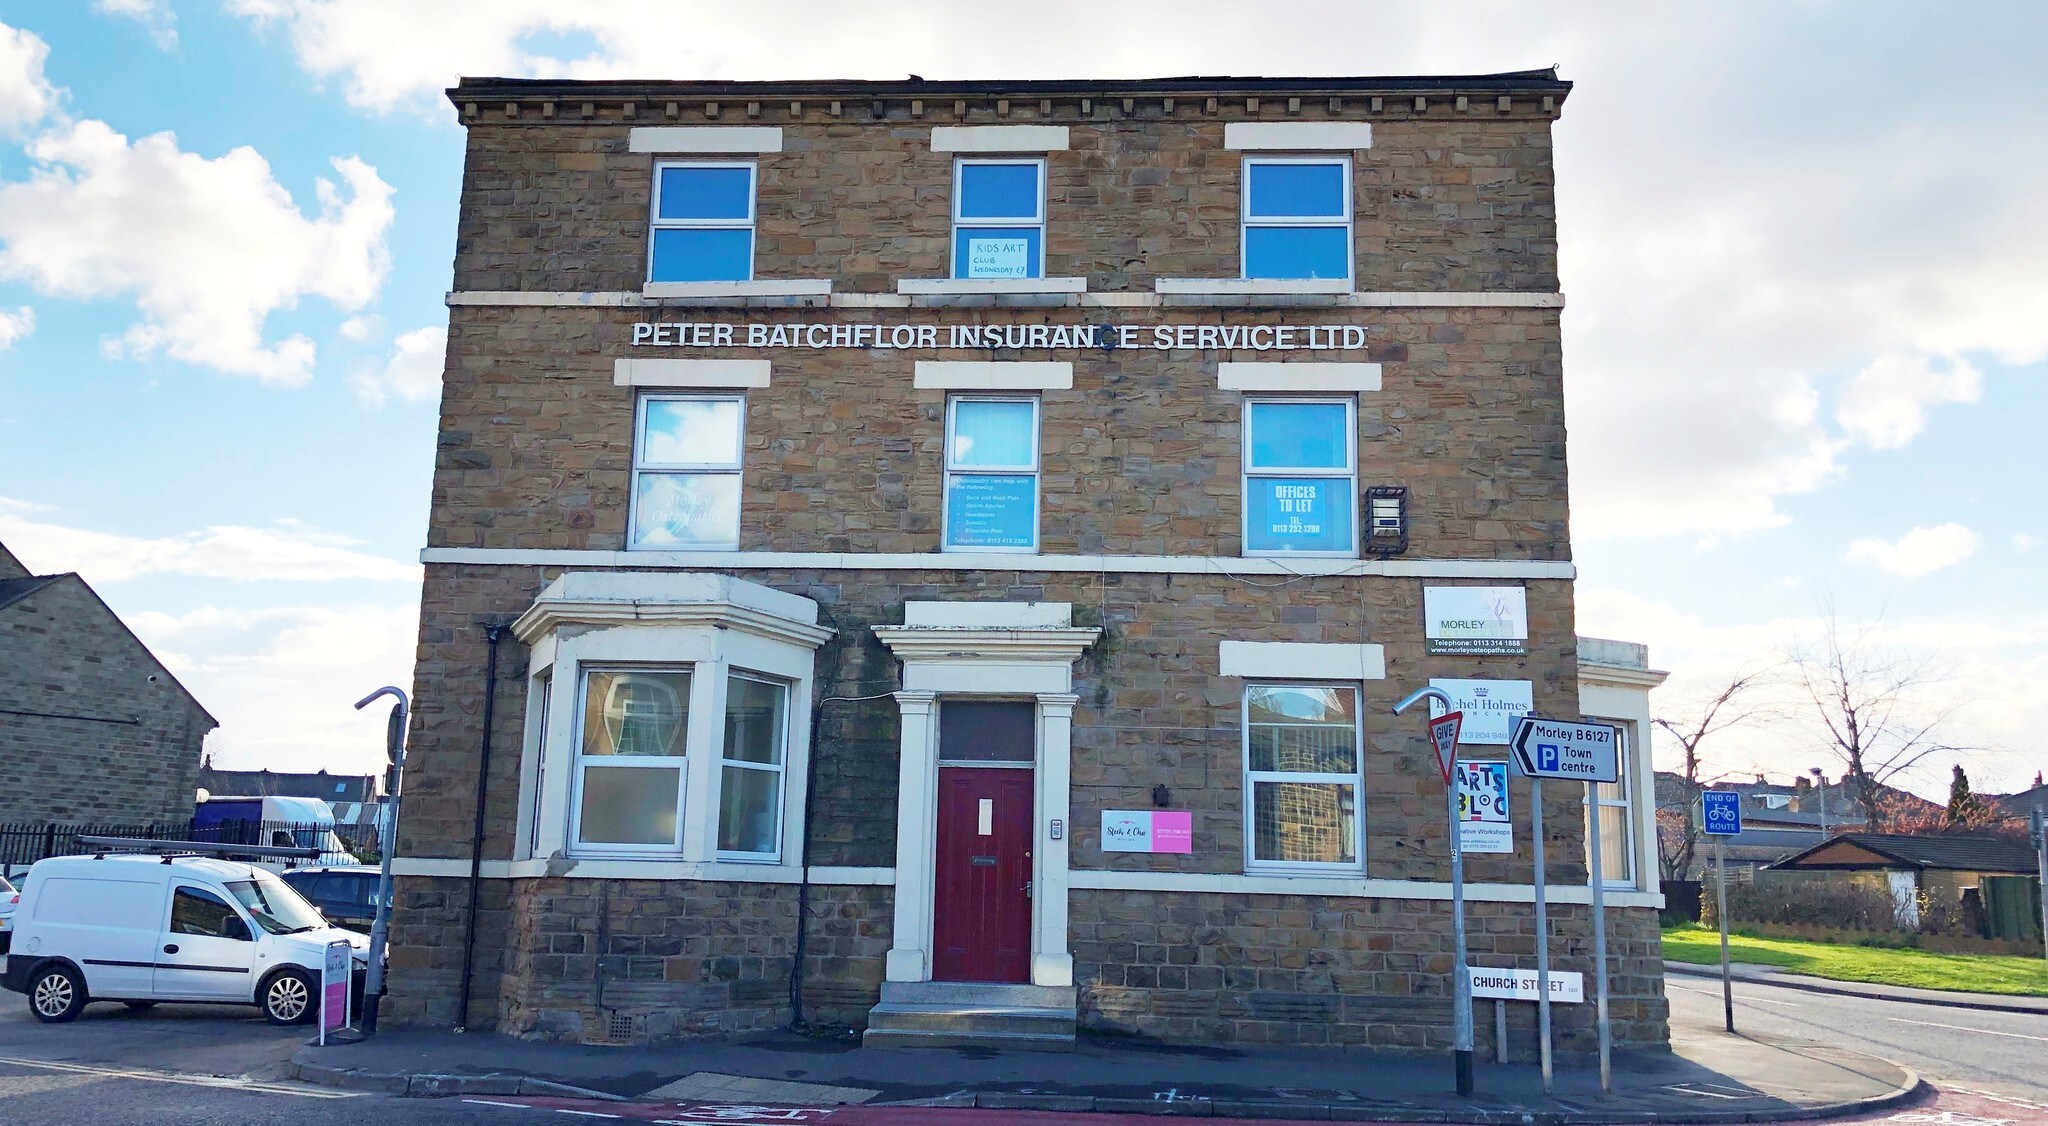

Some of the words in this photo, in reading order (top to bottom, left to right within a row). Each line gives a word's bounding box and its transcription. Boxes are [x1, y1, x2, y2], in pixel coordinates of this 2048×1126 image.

[976, 243, 1000, 253] KIDS
[1002, 243, 1025, 253] ART
[632, 322, 734, 347] PETER
[1153, 325, 1293, 350] SERVICE
[1309, 325, 1365, 350] LTD
[1275, 485, 1316, 498] OFFICES
[1279, 499, 1292, 512] TO
[1296, 499, 1312, 512] LET
[1441, 620, 1485, 629] MORLEY
[1434, 639, 1472, 647] Telephone:
[1436, 699, 1477, 709] Rchel
[1482, 699, 1528, 710] Holmes
[1436, 724, 1453, 740] GIVE
[1536, 725, 1572, 741] Morley
[1441, 740, 1451, 750] WAY
[1564, 746, 1592, 759] Town
[1561, 762, 1596, 773] centre
[1458, 767, 1504, 792] ARTS
[1706, 794, 1723, 802] END
[1710, 822, 1736, 830] ROUTE
[1473, 976, 1518, 989] CHURCH
[1522, 979, 1564, 992] STET
